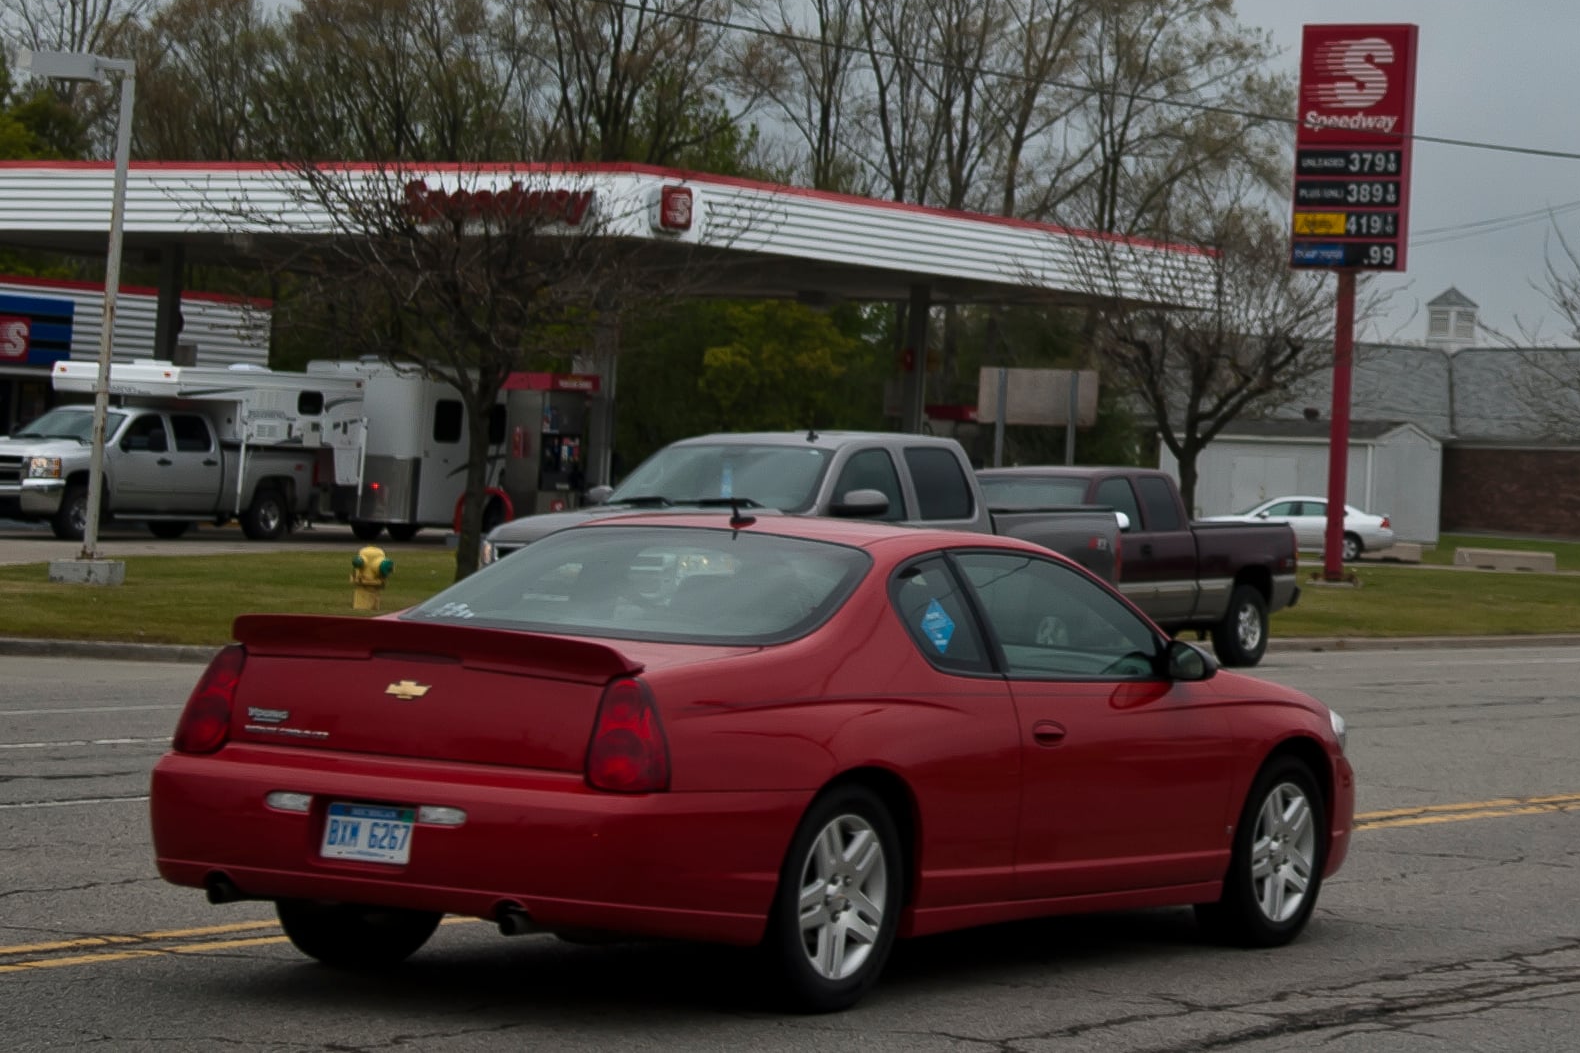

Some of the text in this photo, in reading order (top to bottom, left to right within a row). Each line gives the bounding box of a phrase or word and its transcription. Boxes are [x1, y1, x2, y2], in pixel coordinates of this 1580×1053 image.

[1303, 109, 1398, 133] Speedway
[1347, 152, 1386, 173] 379
[1346, 183, 1383, 203] 389
[1346, 214, 1381, 235] 419
[367, 821, 411, 851] 6267
